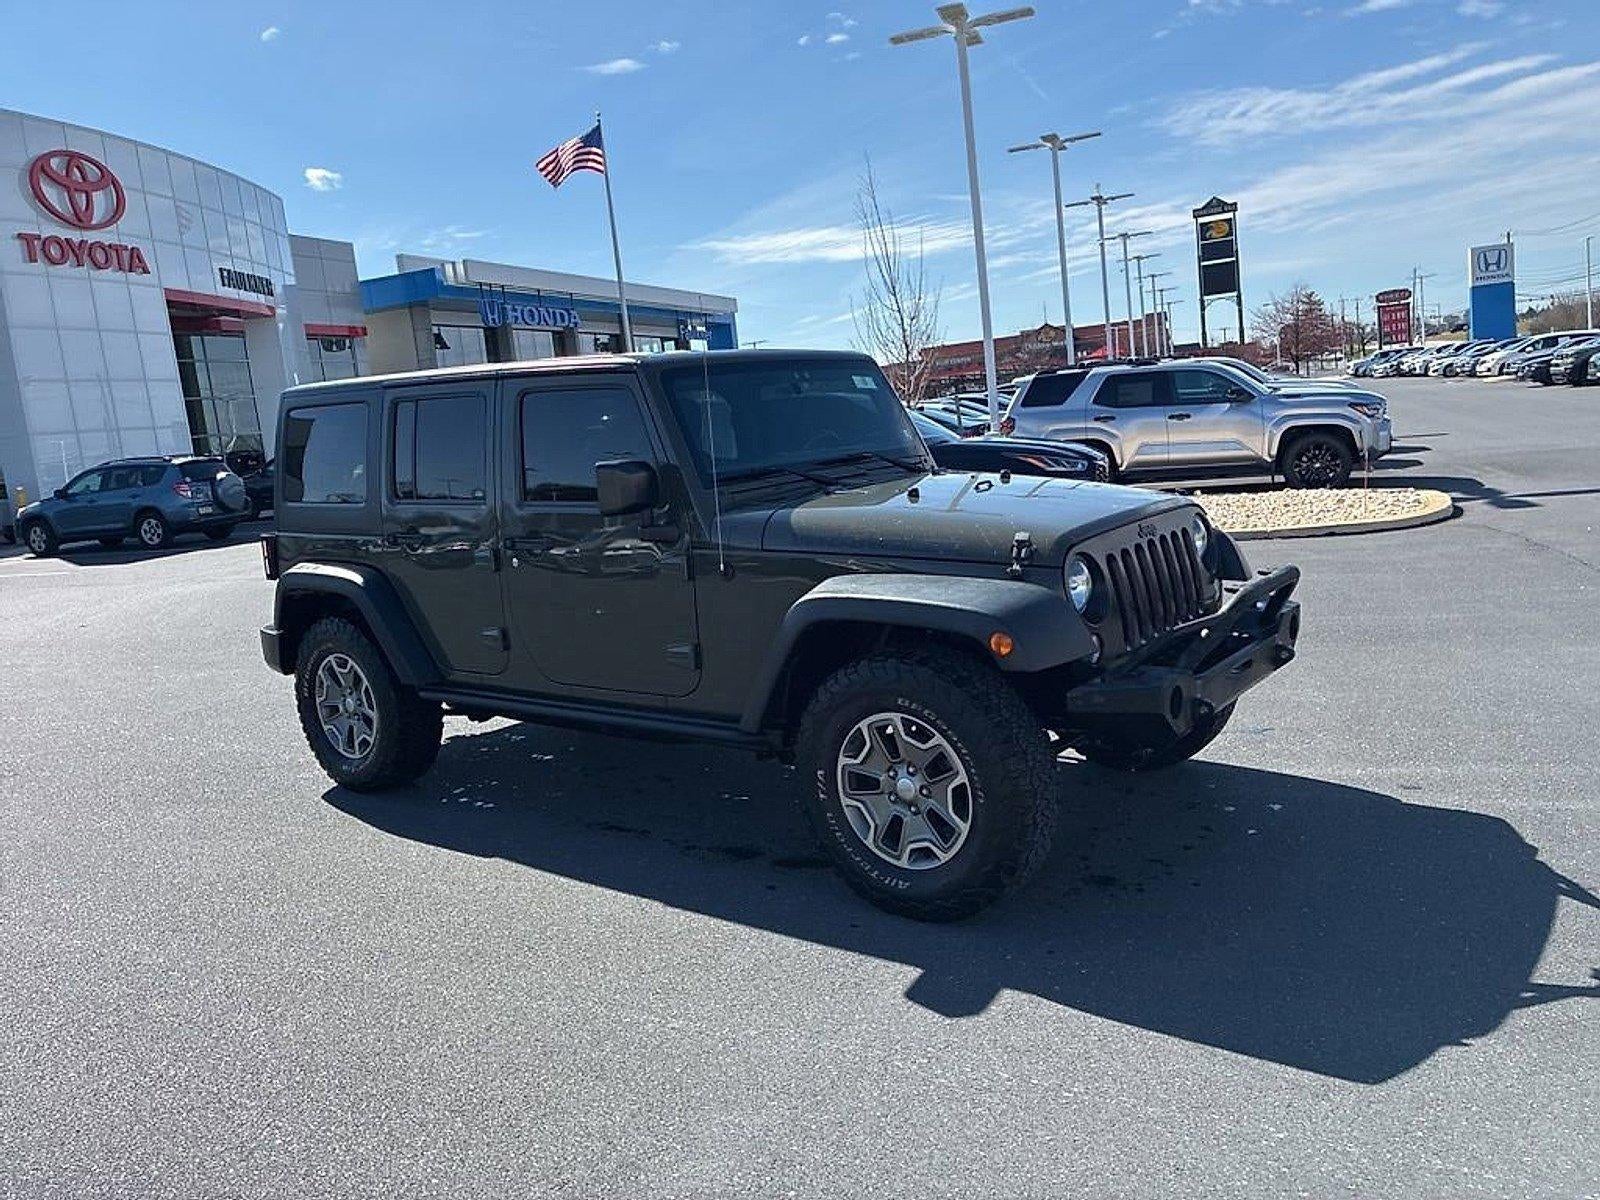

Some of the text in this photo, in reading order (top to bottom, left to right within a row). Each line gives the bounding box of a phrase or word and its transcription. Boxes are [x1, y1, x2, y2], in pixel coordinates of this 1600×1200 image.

[17, 232, 151, 275] TOYOTA
[218, 267, 275, 297] FAULKNER
[505, 304, 581, 328] HONDA
[1137, 523, 1158, 539] Jeep
